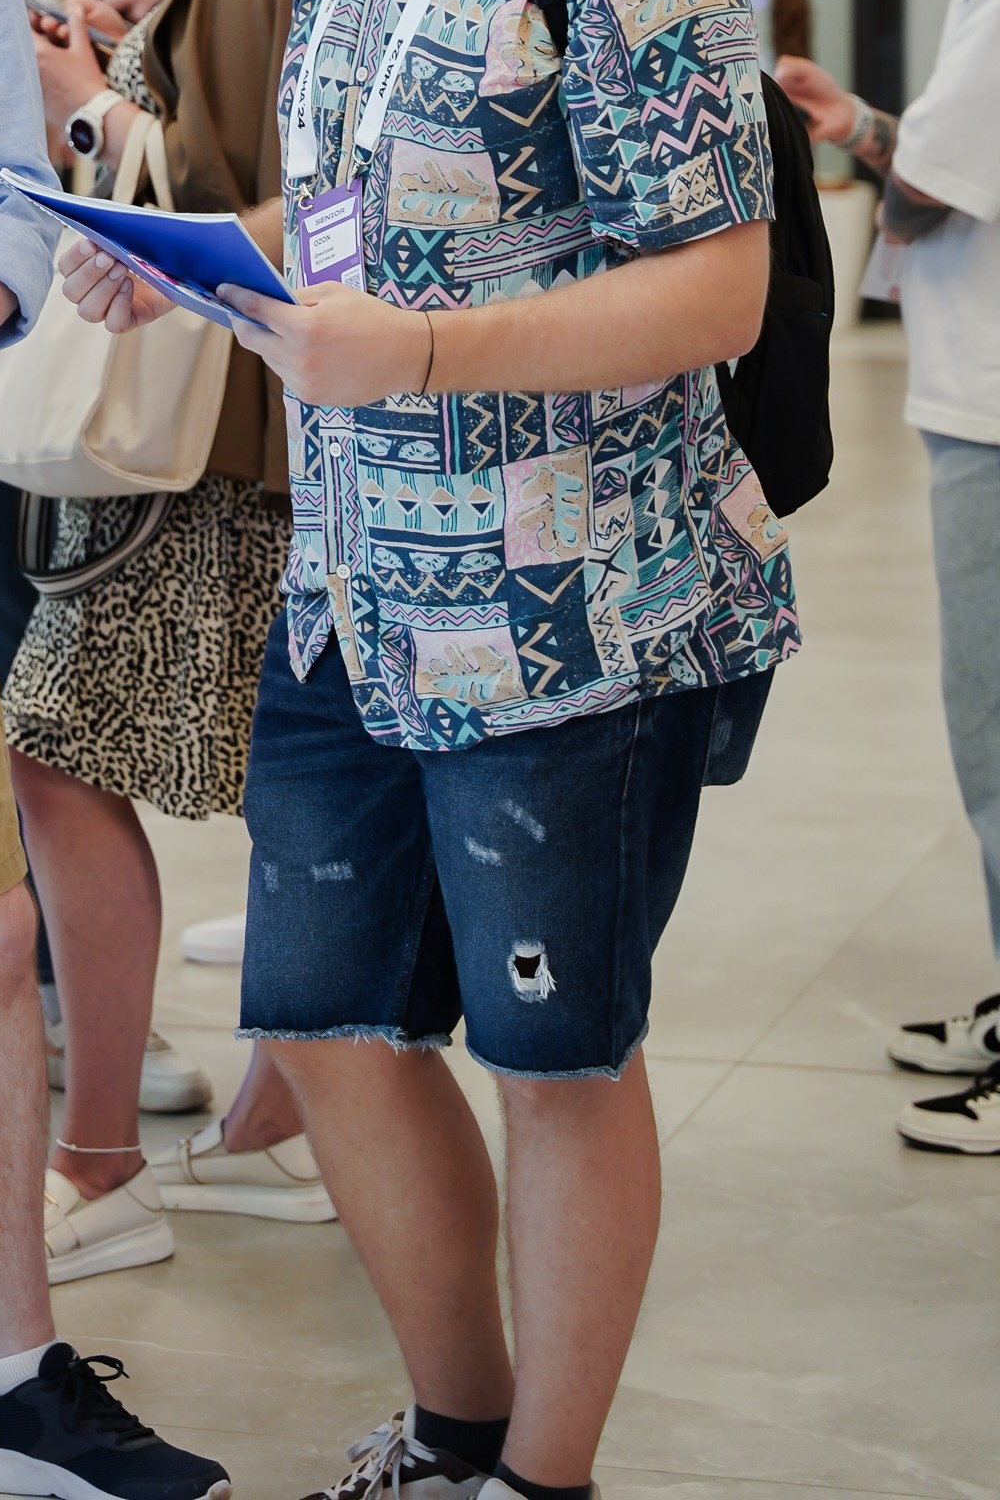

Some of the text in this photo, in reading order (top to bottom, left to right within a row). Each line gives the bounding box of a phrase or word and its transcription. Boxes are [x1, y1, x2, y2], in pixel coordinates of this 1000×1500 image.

[378, 38, 403, 99] AHA'24
[315, 208, 345, 225] SENIOR
[314, 234, 331, 246] OZON
